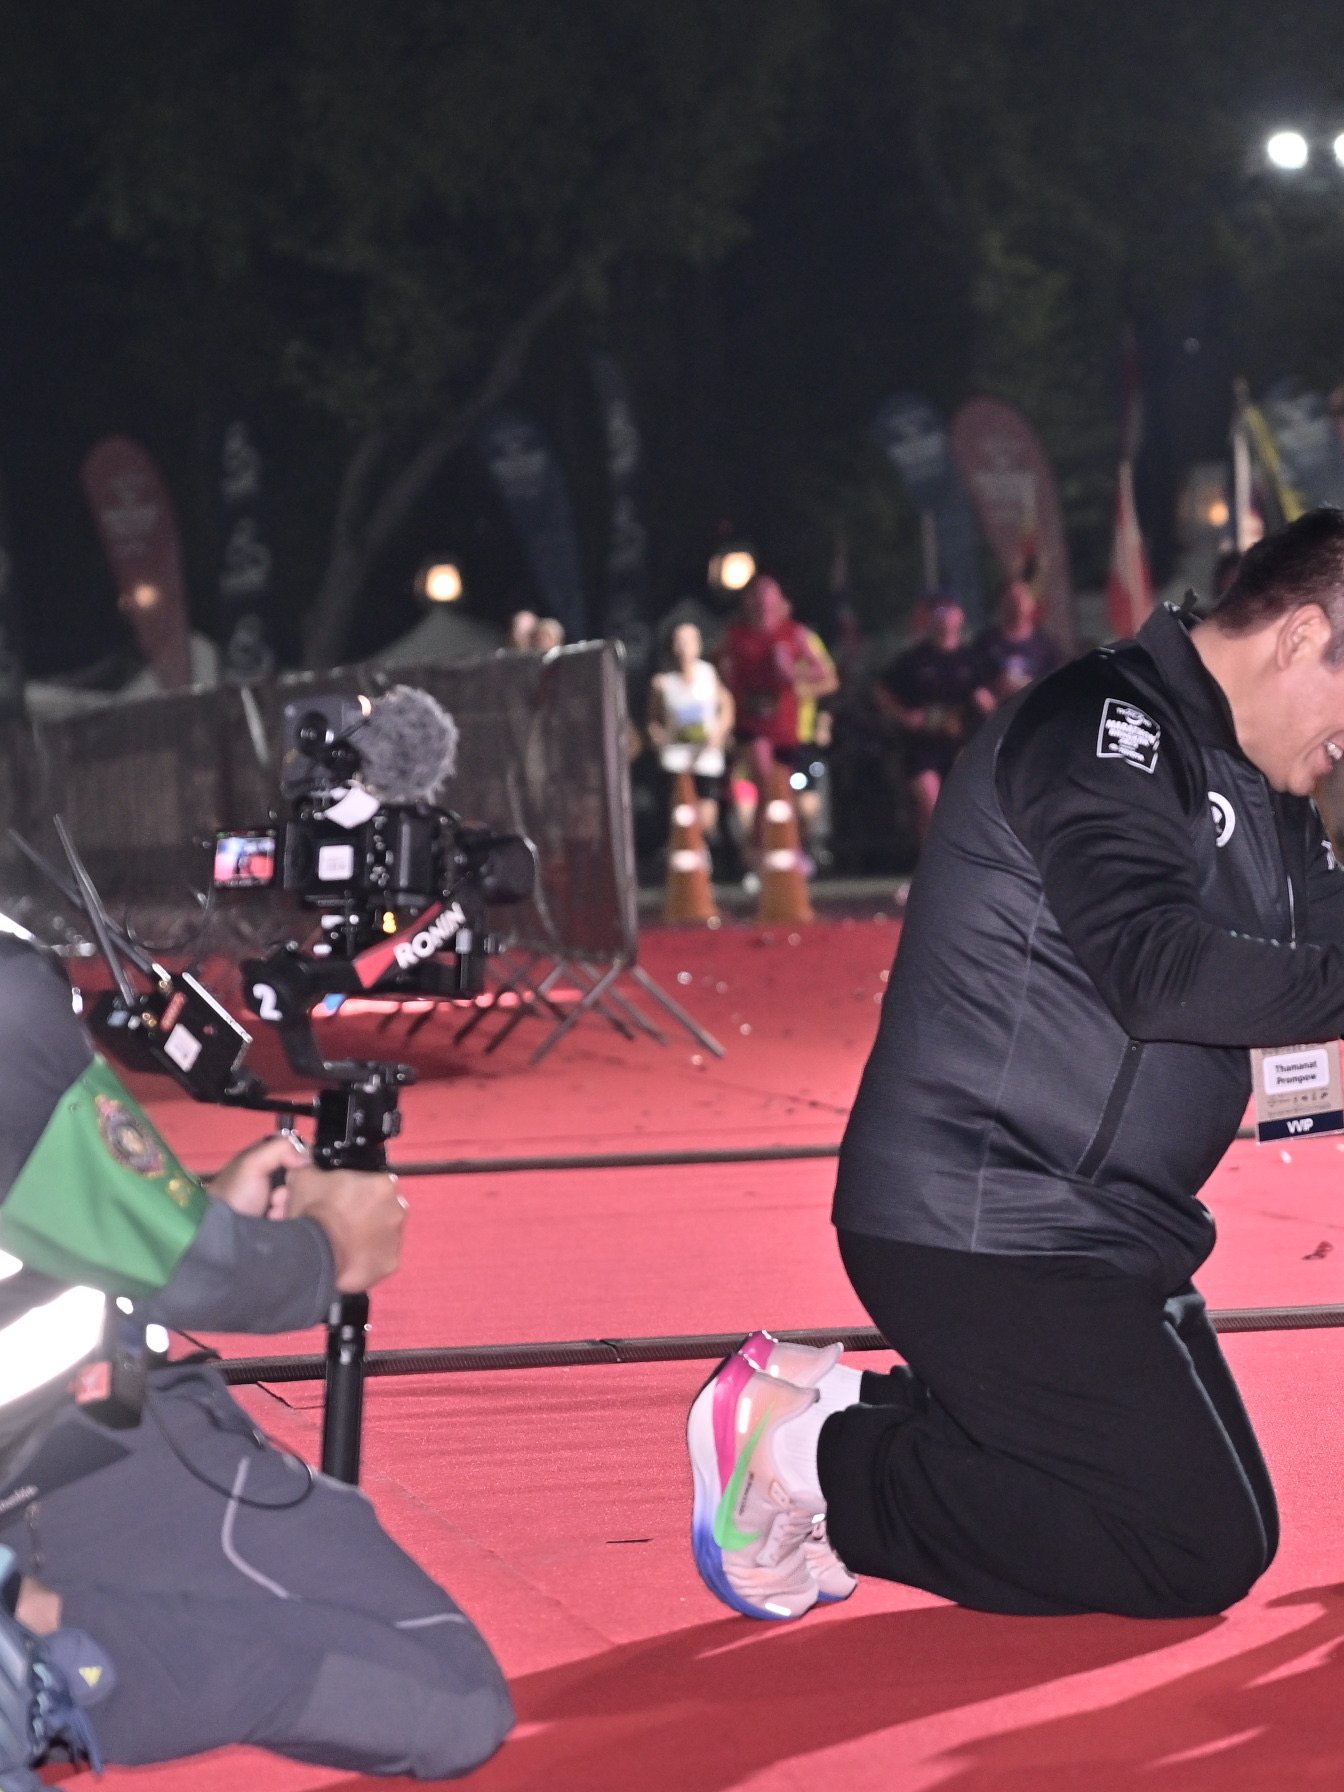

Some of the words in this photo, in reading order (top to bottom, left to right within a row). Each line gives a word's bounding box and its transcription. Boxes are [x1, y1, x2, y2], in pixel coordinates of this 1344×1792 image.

[393, 901, 466, 969] RONIN
[252, 983, 283, 1021] 2
[1286, 1118, 1314, 1133] VVIP
